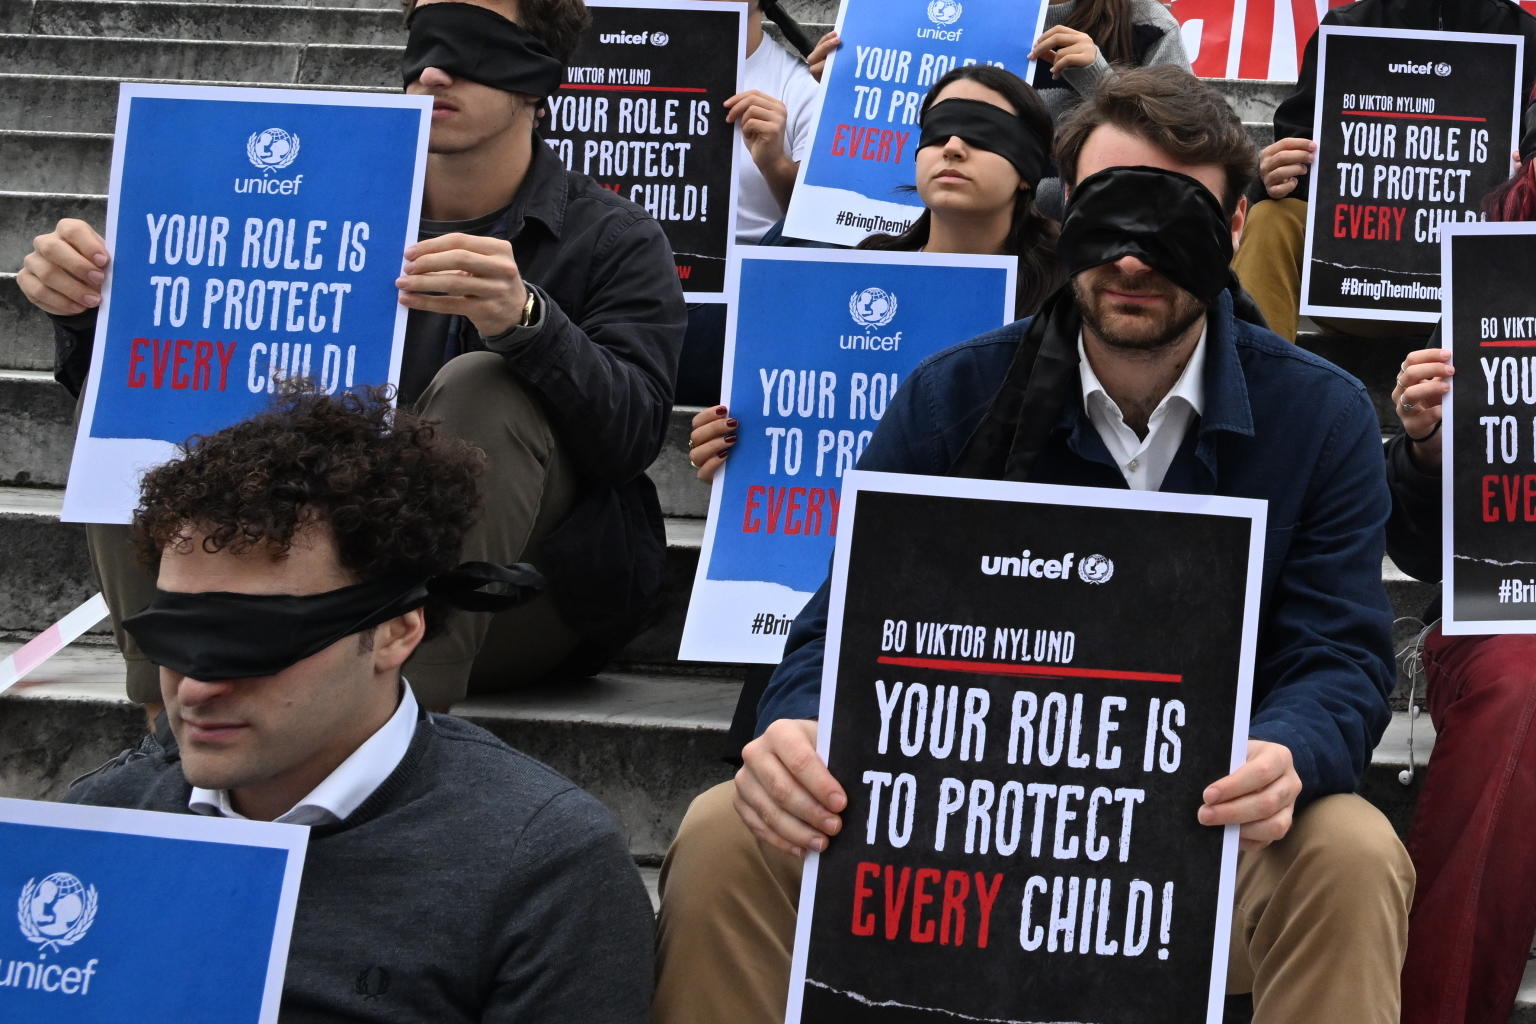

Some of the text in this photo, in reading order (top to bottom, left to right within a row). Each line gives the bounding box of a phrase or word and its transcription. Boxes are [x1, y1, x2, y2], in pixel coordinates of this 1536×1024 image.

[600, 30, 648, 44] unicef
[917, 26, 963, 42] unicef
[568, 67, 650, 85] VIKTOR NYLUND
[855, 46, 912, 84] YOUR
[1389, 61, 1432, 74] unicef
[547, 96, 710, 135] YOUR ROLE IS
[854, 86, 881, 120] TO
[1344, 94, 1435, 114] BO VIKTOR NYLUND
[584, 140, 691, 177] PROTECT
[831, 124, 910, 164] EVERY
[1341, 122, 1488, 162] YOUR ROLE IS
[235, 174, 303, 195] unicef
[1337, 163, 1470, 203] TO PROTECT
[630, 184, 708, 222] CHILD!
[1333, 204, 1407, 240] EVERY
[146, 213, 370, 272] YOUR ROLE IS
[150, 276, 351, 334] TO PROTECT
[840, 331, 902, 351] unicef
[1481, 318, 1498, 339] BO
[128, 337, 237, 391] EVERY
[759, 368, 837, 420] YOUR
[765, 427, 803, 476] TO
[1480, 415, 1519, 464] TO
[743, 485, 842, 536] EVERY
[981, 550, 1074, 580] unicef
[882, 619, 1076, 664] BO VIKTOR NYLUND
[875, 680, 1186, 773] YOUR ROLE IS
[862, 771, 1145, 863] TO PROTECT
[850, 861, 1175, 961] EVERY CHILD!
[0, 953, 98, 996] unicef
